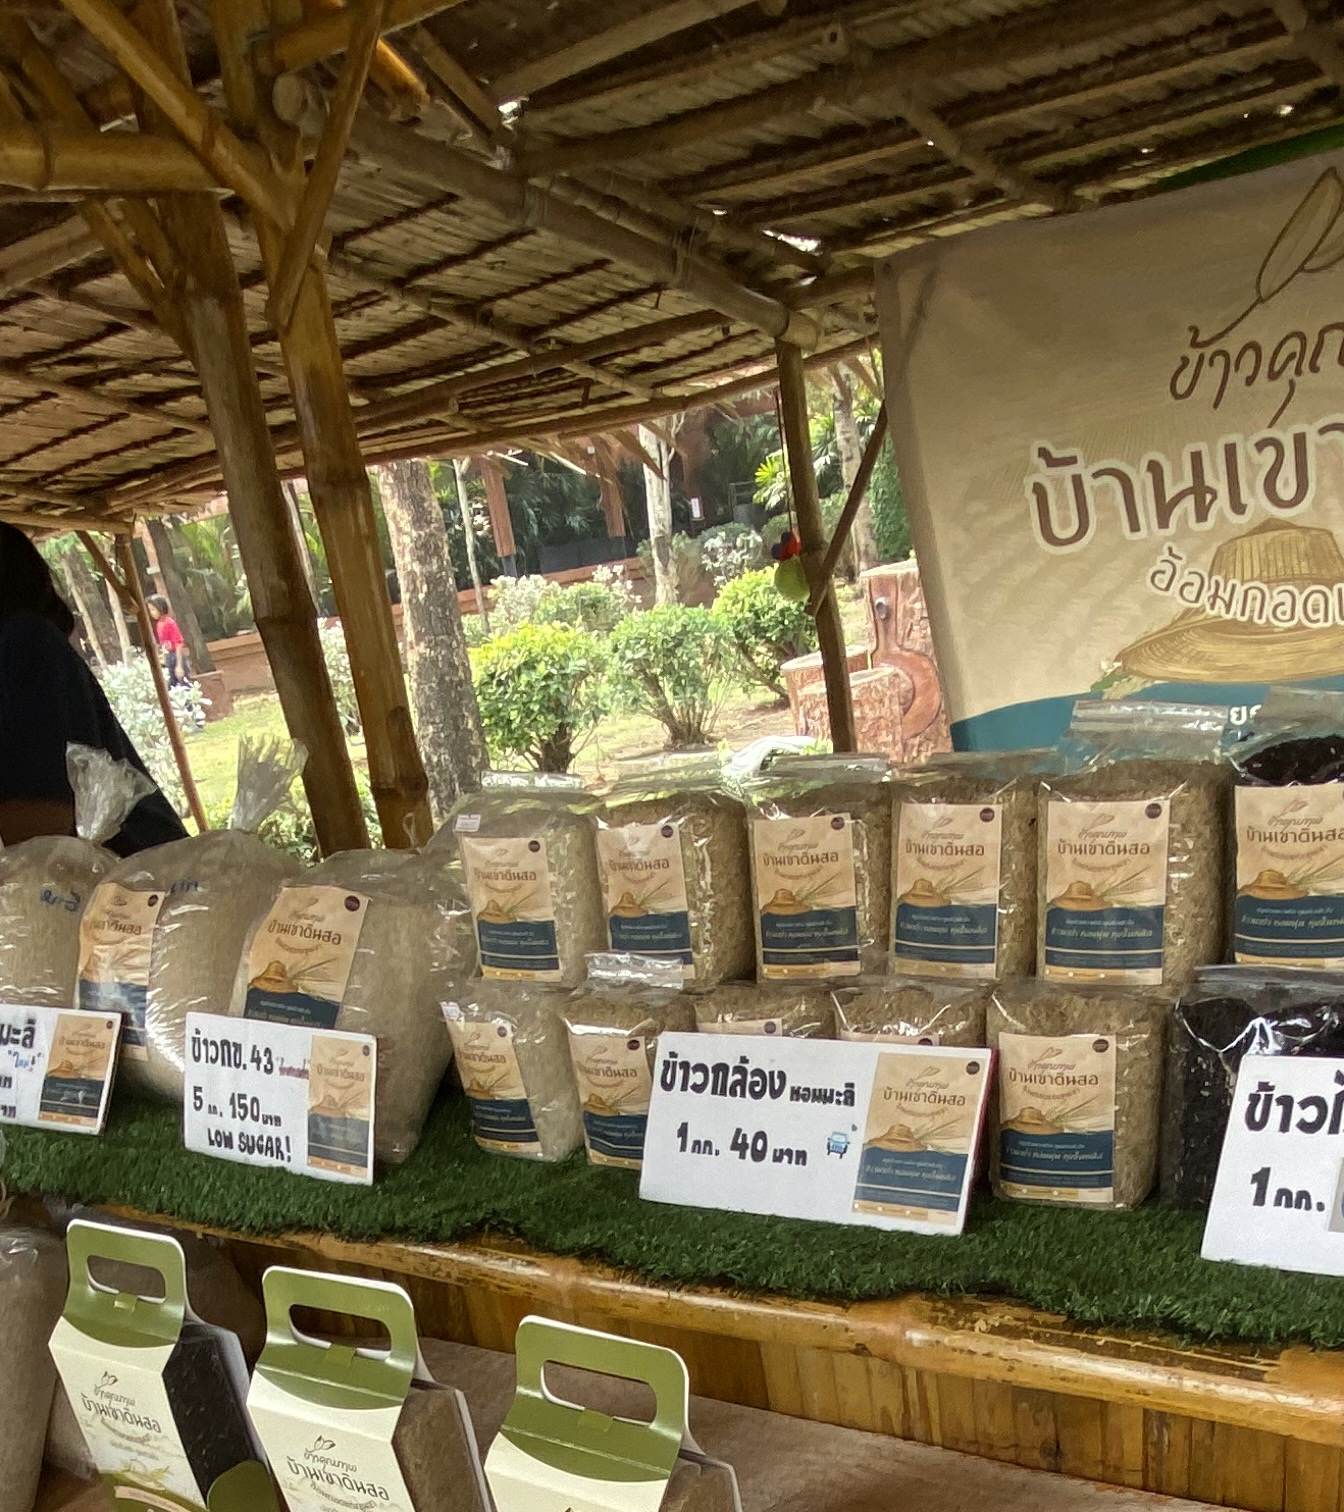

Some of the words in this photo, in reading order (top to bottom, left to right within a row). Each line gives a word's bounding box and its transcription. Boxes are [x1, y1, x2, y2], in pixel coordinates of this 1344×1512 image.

[905, 839, 984, 856] บ้านเขาดินสอ
[1057, 839, 1150, 855] บ้านเขาดินสอ
[251, 1045, 274, 1075] 43
[660, 1051, 787, 1100] ข้าวกล้อง
[1009, 1067, 1099, 1086] บ้านเขาดินสอ
[193, 1086, 203, 1111] 5
[229, 1092, 260, 1122] 150
[262, 1114, 281, 1127] บาท
[883, 1086, 966, 1107] บ้านเขาดินสอ
[207, 1128, 234, 1150] LOW
[238, 1132, 291, 1163] SUGAR!
[677, 1122, 688, 1153] 1
[691, 1138, 720, 1156] กก.
[730, 1127, 768, 1163] 40
[772, 1147, 808, 1166] บาท
[1250, 1166, 1272, 1207] 1
[1273, 1188, 1325, 1212] กก.
[81, 1392, 161, 1433] บ้านเขาดินสอ
[286, 1455, 389, 1501] บ้านเขาดินสอ
